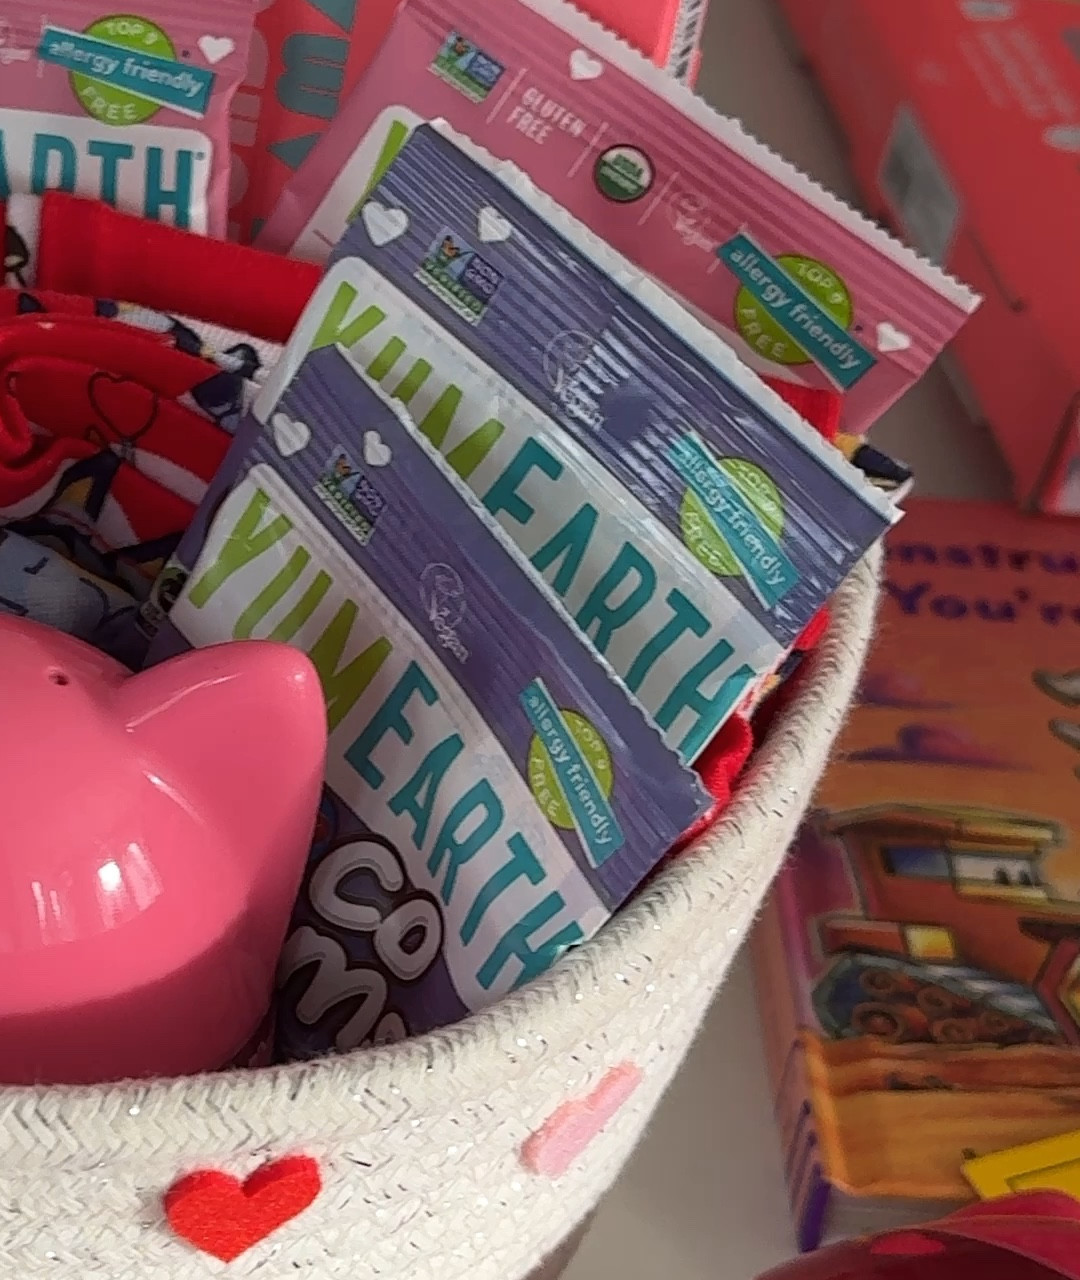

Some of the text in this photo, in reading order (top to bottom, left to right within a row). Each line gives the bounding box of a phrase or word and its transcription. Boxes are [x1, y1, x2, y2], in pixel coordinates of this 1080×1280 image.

[48, 40, 121, 75] allergy
[121, 57, 205, 98] friendly
[81, 85, 138, 121] FREE
[507, 105, 554, 146] FREE
[520, 87, 587, 138] GLUTEN
[728, 247, 863, 371] allergy friendly
[739, 307, 788, 359] FREE
[725, 508, 786, 586] friendly
[527, 695, 613, 845] allergy friendly
